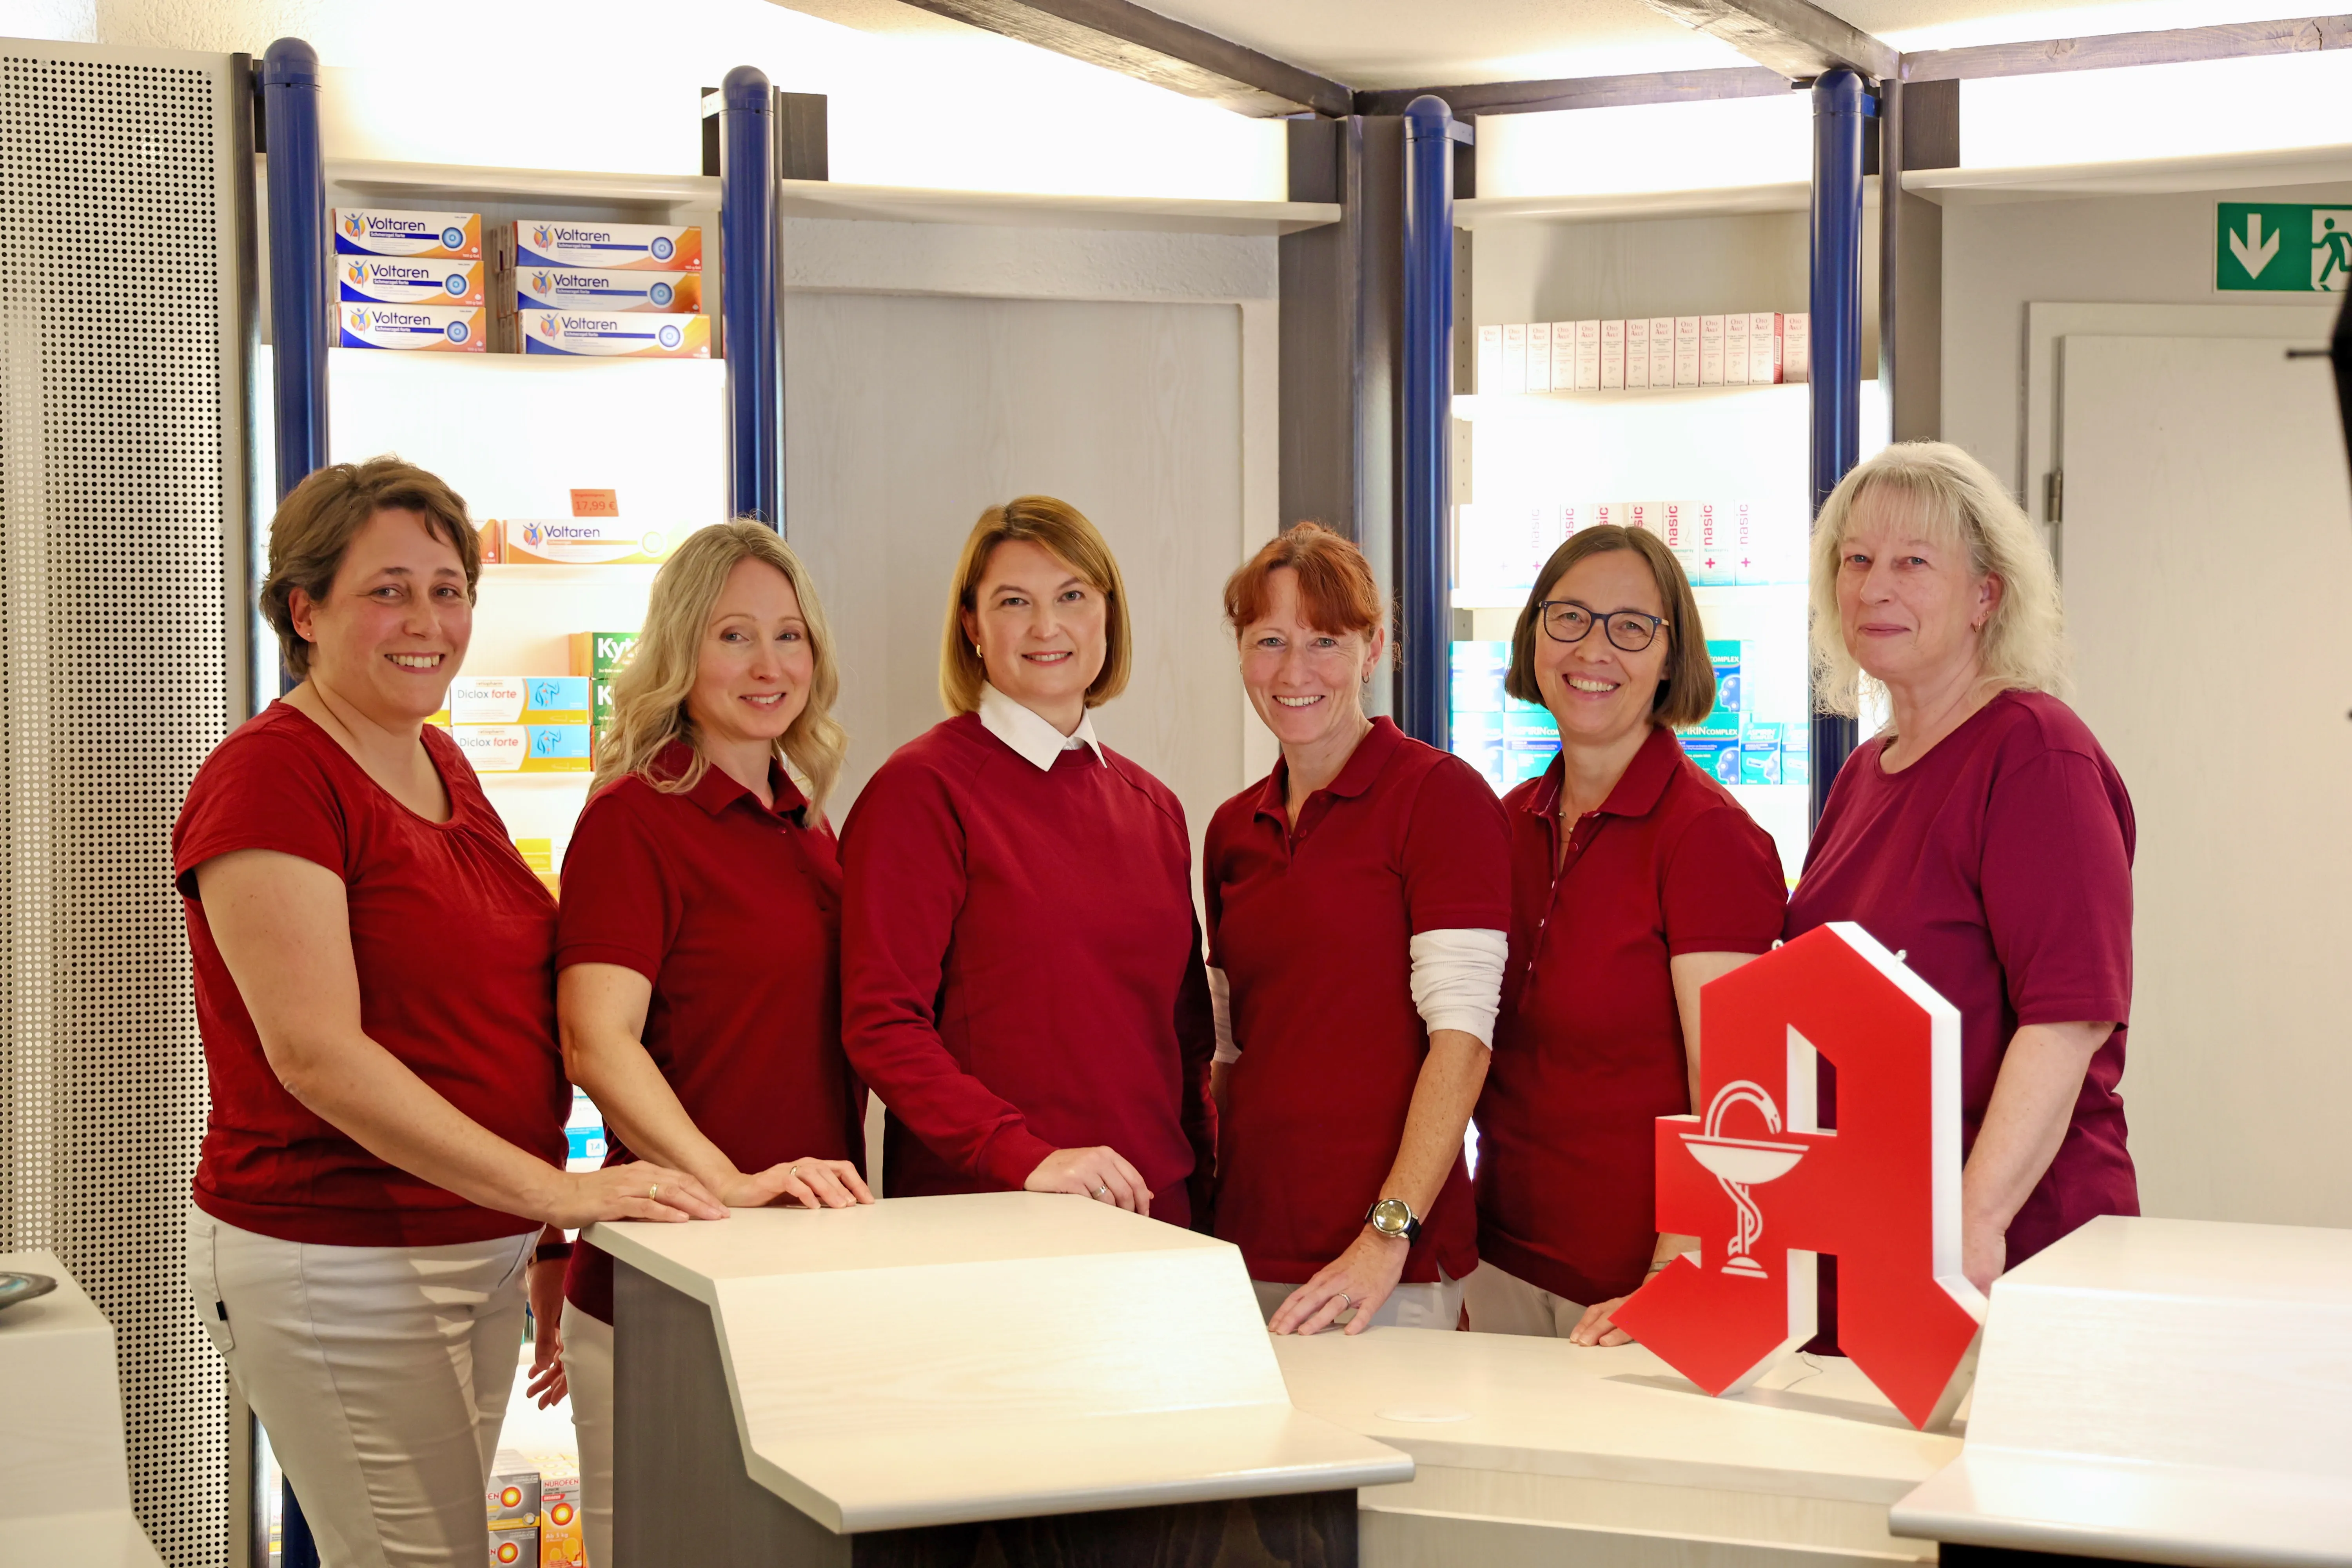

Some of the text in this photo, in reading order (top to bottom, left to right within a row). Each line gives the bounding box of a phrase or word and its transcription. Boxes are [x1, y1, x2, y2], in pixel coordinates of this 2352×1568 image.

[367, 216, 426, 231] Voltaren
[554, 228, 610, 241] Voltaren
[370, 264, 429, 278] Voltaren
[553, 274, 609, 287] Voltaren
[372, 311, 431, 325] Voltaren
[561, 316, 617, 330] Voltaren
[576, 501, 615, 511] 17,99 €
[1563, 508, 1574, 538] asic
[1666, 505, 1678, 546] nasic
[1700, 505, 1713, 546] nasic
[1736, 504, 1748, 544] nasic
[544, 526, 600, 537] Voltaren
[457, 689, 517, 699] Diclox forte
[460, 737, 519, 747] Diclox forte
[544, 1479, 579, 1487] NUROFEN
